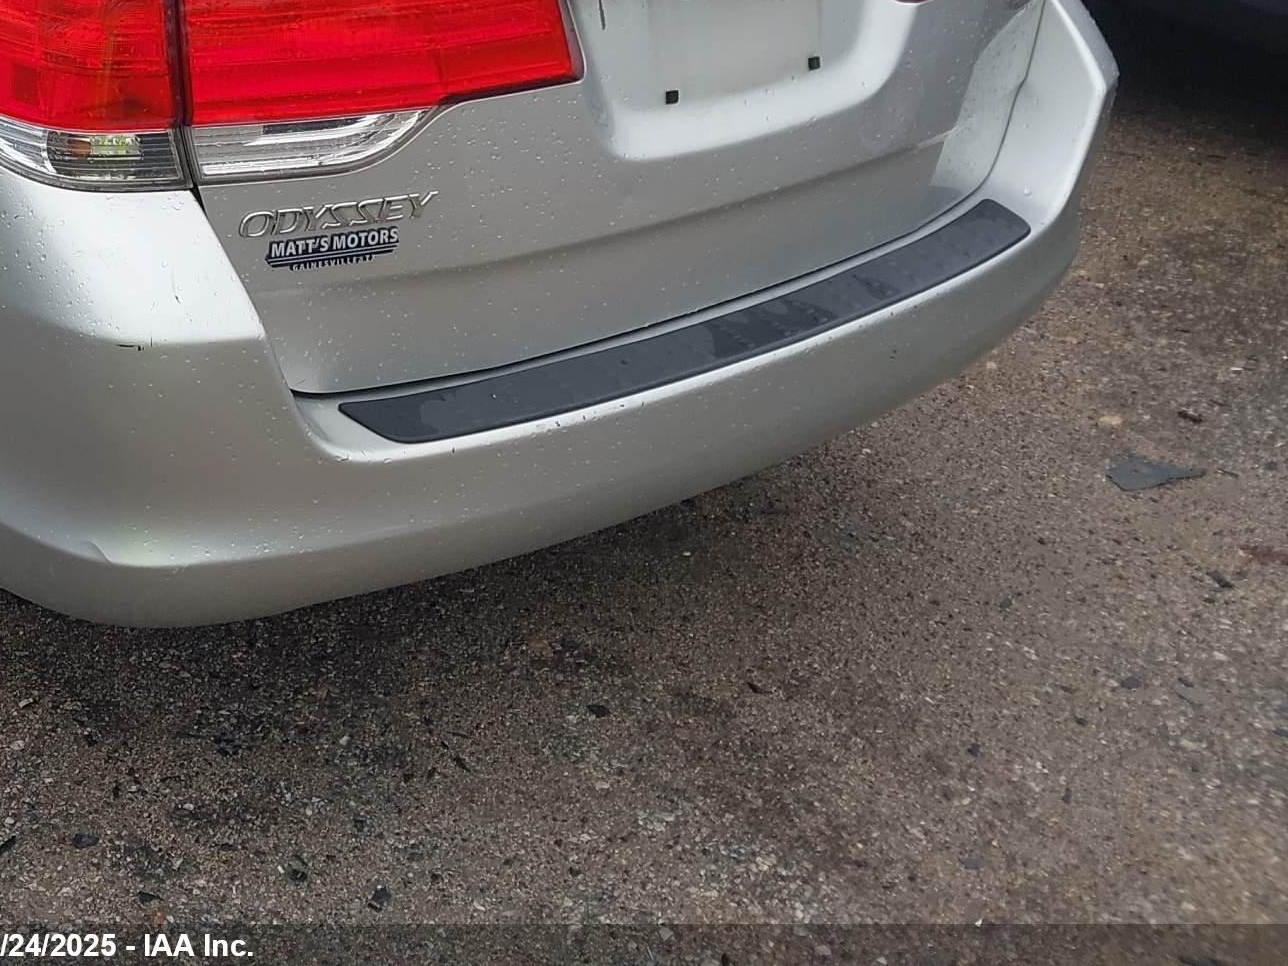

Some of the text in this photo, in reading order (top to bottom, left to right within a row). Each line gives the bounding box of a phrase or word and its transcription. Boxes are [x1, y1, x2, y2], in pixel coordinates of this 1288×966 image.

[239, 190, 439, 237] ODYSSEY
[271, 228, 399, 258] MATT'S MOTORS
